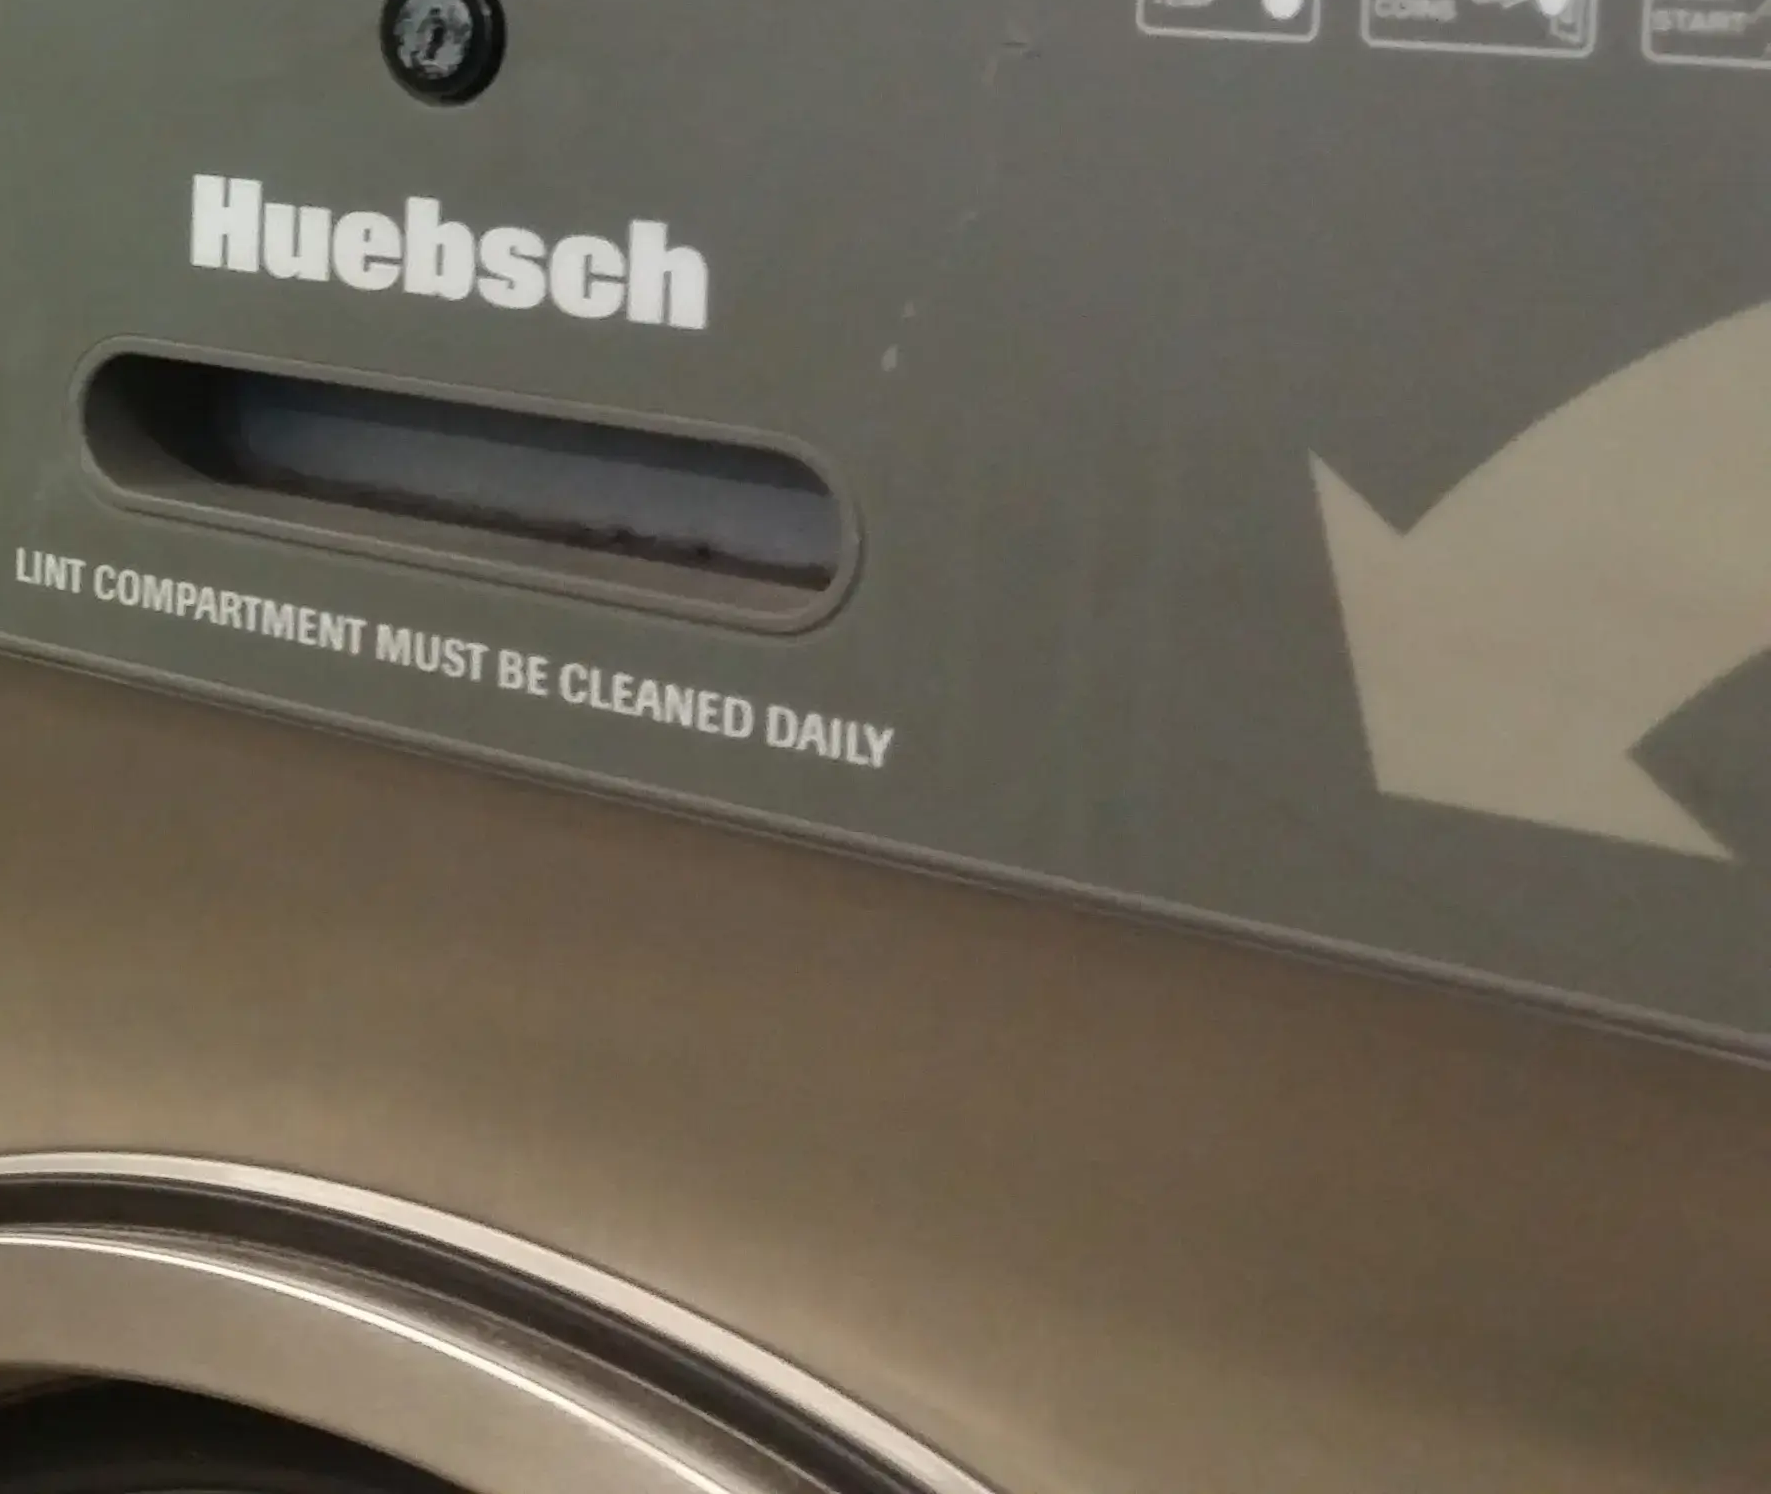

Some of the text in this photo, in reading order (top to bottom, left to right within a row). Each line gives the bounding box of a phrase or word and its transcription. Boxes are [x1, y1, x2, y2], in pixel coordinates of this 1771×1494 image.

[191, 174, 709, 330] Huebsch
[15, 547, 895, 769] LINT COMPARTMENT MUST BE CLEANED DAILY
